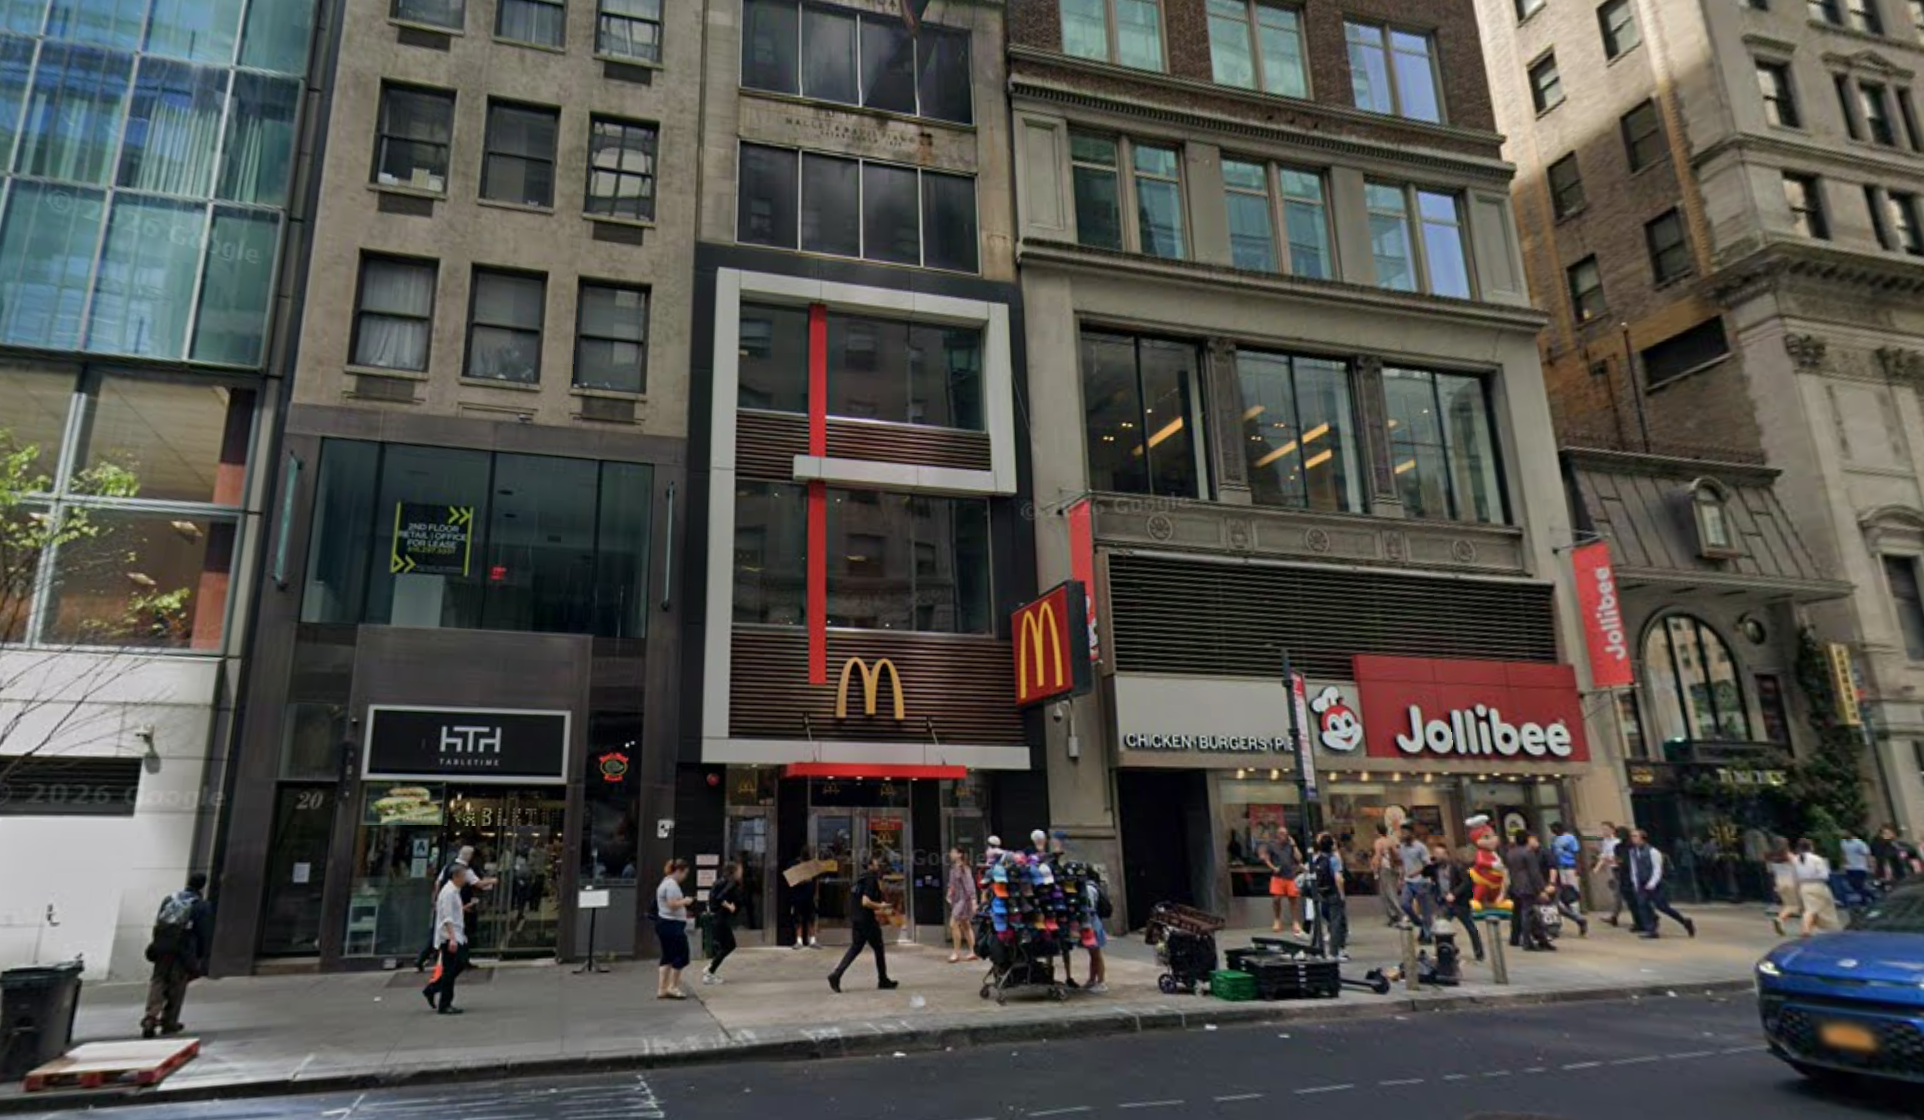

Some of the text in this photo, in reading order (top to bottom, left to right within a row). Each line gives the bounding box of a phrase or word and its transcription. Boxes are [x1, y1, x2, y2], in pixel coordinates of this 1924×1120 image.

[408, 523, 460, 533] 2ND FLOOR
[407, 539, 457, 549] FOR LEASE
[435, 532, 467, 542] OFFICE
[1595, 566, 1627, 661] Jollibee
[1396, 703, 1572, 757] Jollibee
[1126, 733, 1192, 749] CHICKEN
[1199, 735, 1267, 751] BURGERS
[439, 758, 500, 767] TABLETIME
[296, 791, 324, 810] 20
